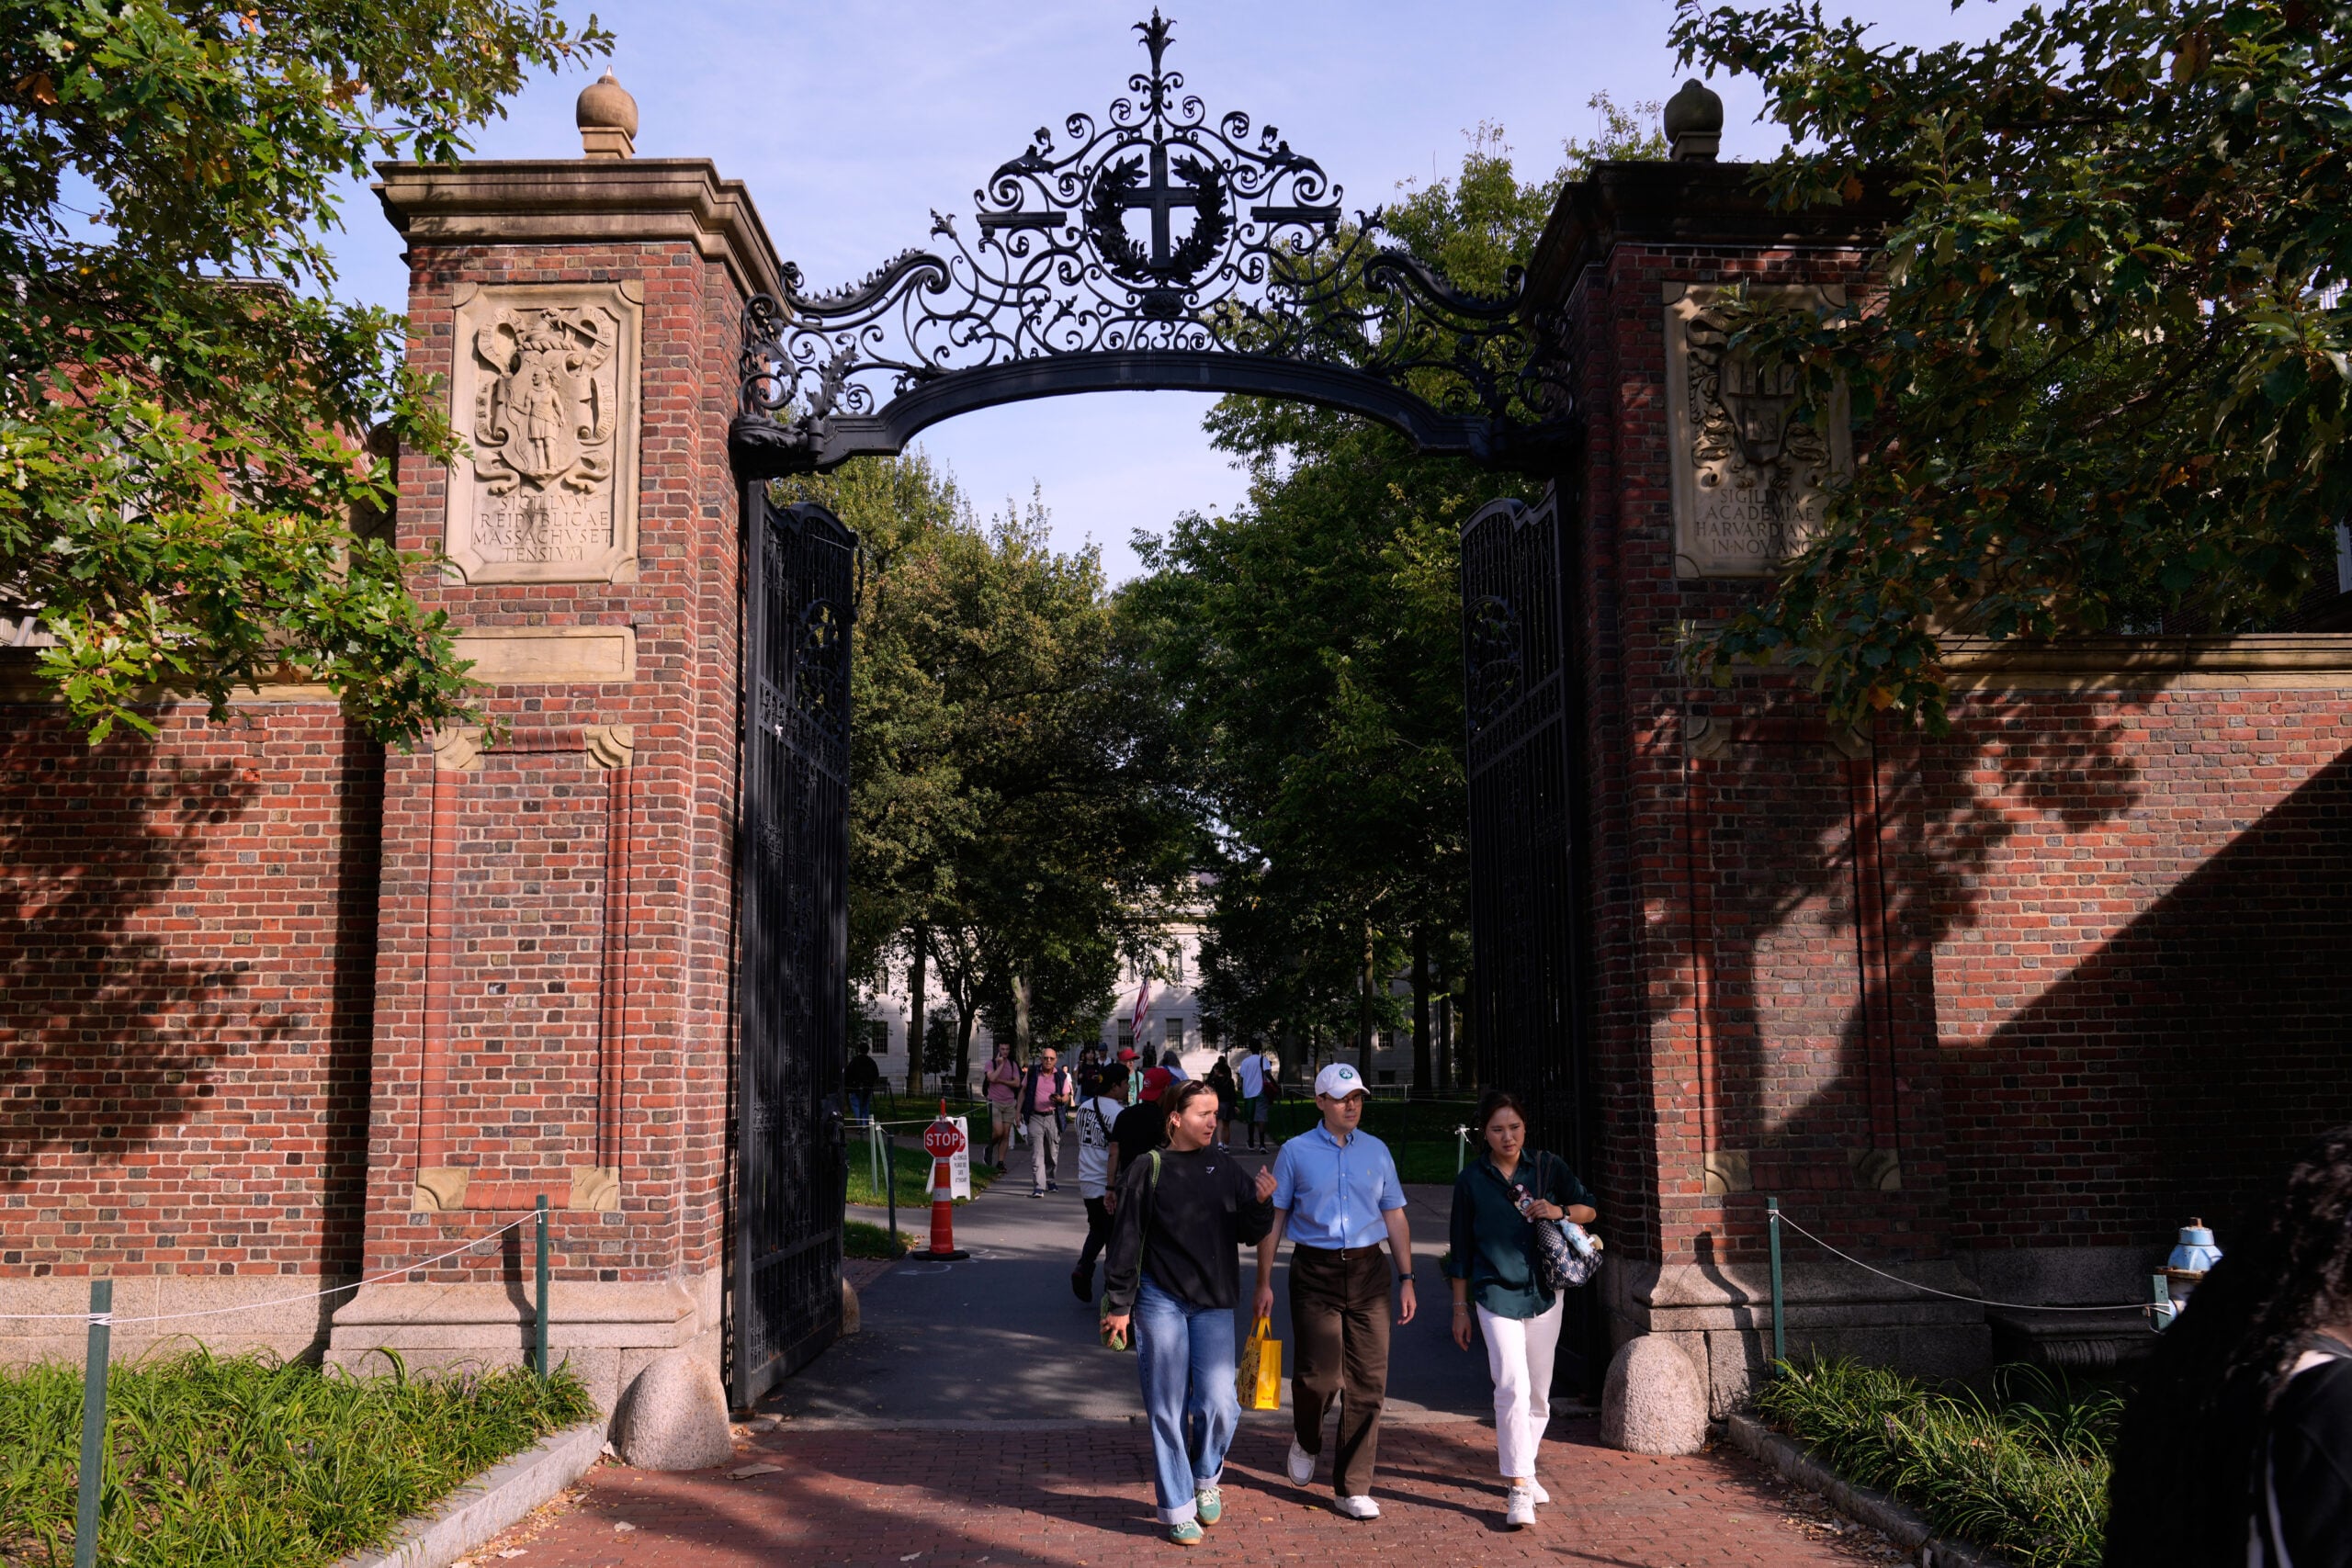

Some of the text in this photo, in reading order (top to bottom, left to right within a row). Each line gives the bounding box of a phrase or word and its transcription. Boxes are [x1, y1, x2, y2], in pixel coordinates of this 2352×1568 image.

[500, 495, 588, 511] SIGILLVM
[1720, 489, 1800, 504] SIGILLVM
[481, 511, 609, 528] REIPVBLICAE
[1705, 506, 1815, 522] ACADEMIAE
[472, 528, 614, 545] MASSACHVSET
[502, 547, 583, 562] TENSIVM
[926, 1133, 959, 1146] STOP
